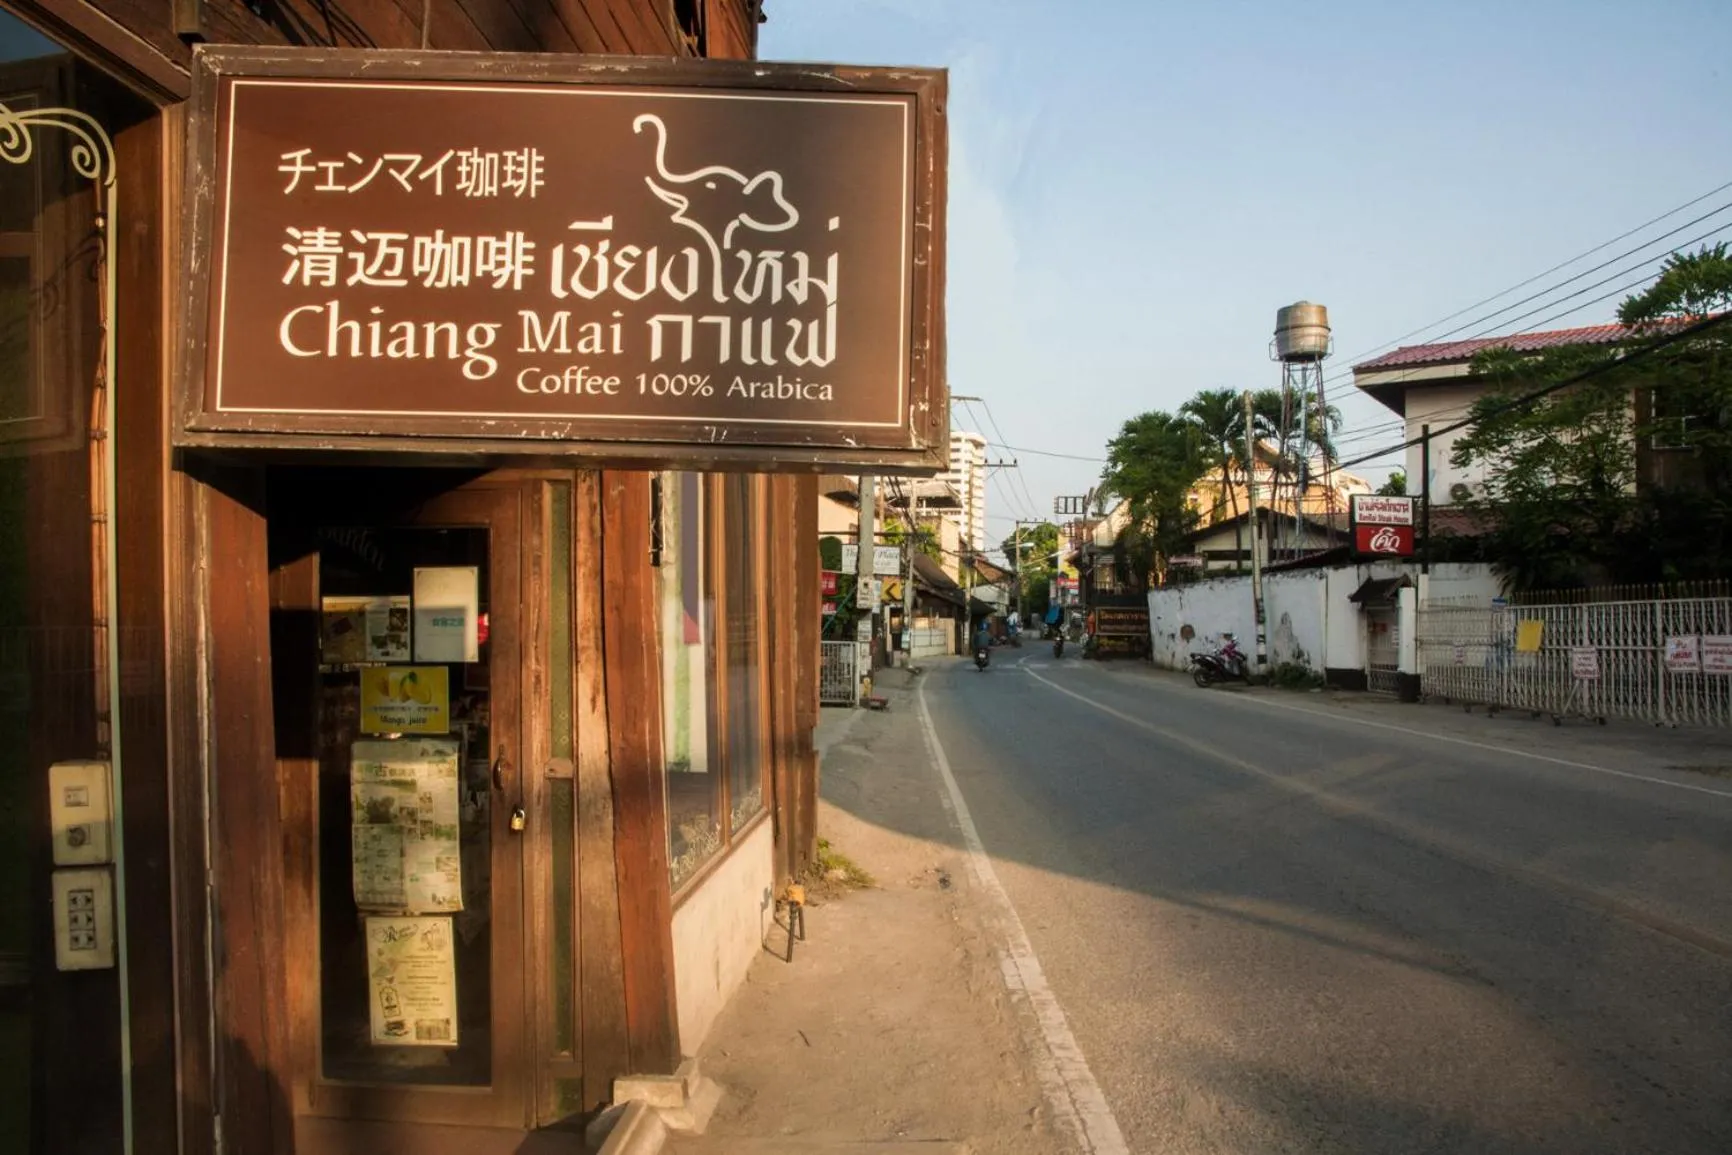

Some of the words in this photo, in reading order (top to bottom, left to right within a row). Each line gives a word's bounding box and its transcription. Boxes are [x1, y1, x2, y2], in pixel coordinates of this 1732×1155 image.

[279, 147, 544, 198] チェンマイ珈琲
[281, 226, 536, 291] 清迈咖啡
[279, 300, 502, 380] Chiang
[517, 309, 624, 355] Mai
[646, 303, 838, 368] กาแฟ
[516, 367, 621, 395] Coffee
[636, 373, 714, 397] 100%
[726, 374, 835, 401] Arabica
